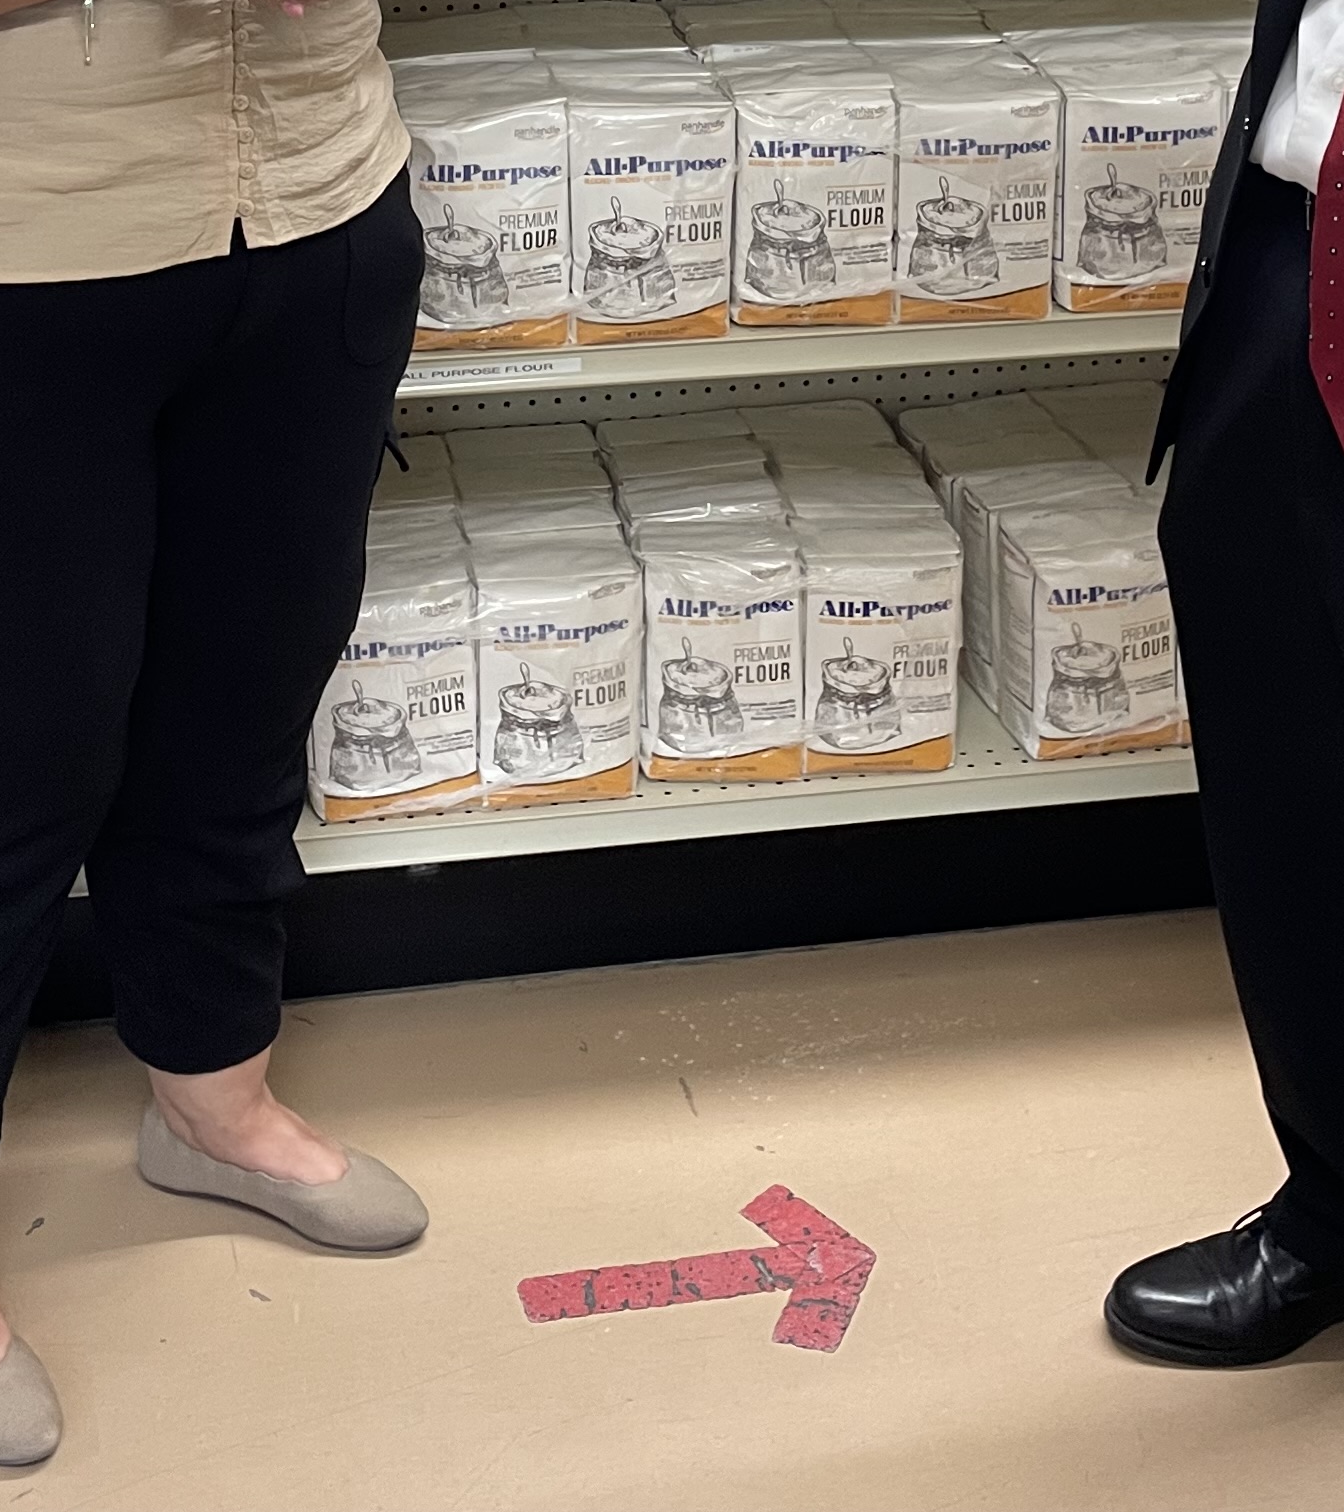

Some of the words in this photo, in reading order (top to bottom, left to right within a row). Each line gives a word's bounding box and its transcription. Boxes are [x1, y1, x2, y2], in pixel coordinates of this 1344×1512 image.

[420, 164, 562, 185] All-Purpose
[584, 156, 727, 176] All-Purpose
[826, 188, 885, 207] PREMIUM
[1159, 191, 1206, 209] FLOU
[499, 210, 558, 228] PREMIUM
[665, 202, 723, 221] PREMIUM
[500, 229, 557, 252] FLOUR
[665, 221, 722, 244] FLOUR
[401, 371, 427, 380] ALL
[431, 366, 501, 379] PURPOSE
[505, 362, 553, 373] FLOUR
